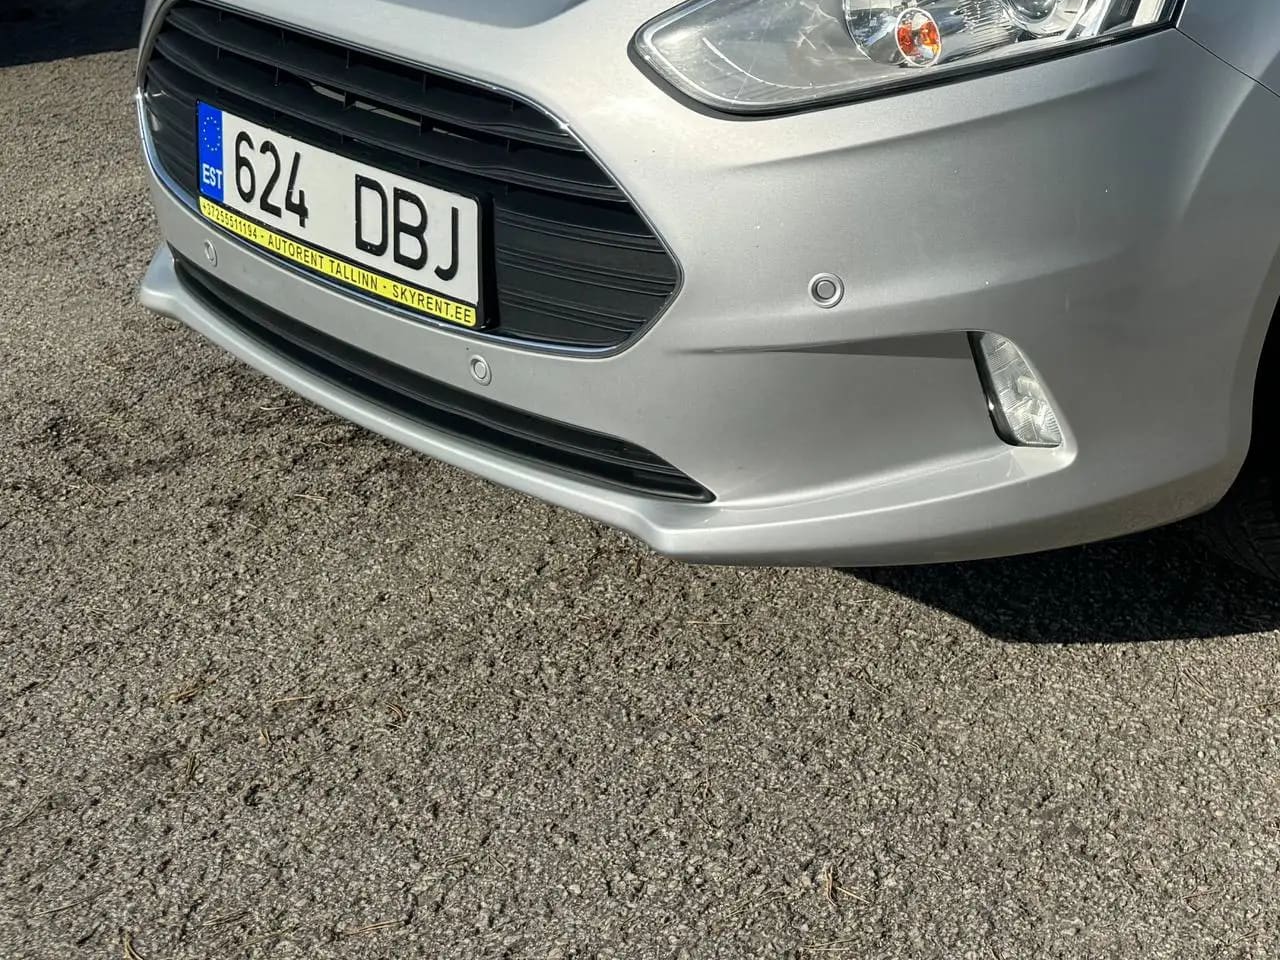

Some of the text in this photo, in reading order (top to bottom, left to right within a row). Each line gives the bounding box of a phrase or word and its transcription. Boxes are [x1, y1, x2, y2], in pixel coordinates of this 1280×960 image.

[202, 163, 223, 189] EST
[235, 131, 459, 281] 624 DBJ
[202, 204, 258, 240] +37255511194
[268, 234, 326, 272] AUTORENT
[328, 259, 378, 291] TALLINN
[392, 284, 472, 323] SKYRENT.EE
